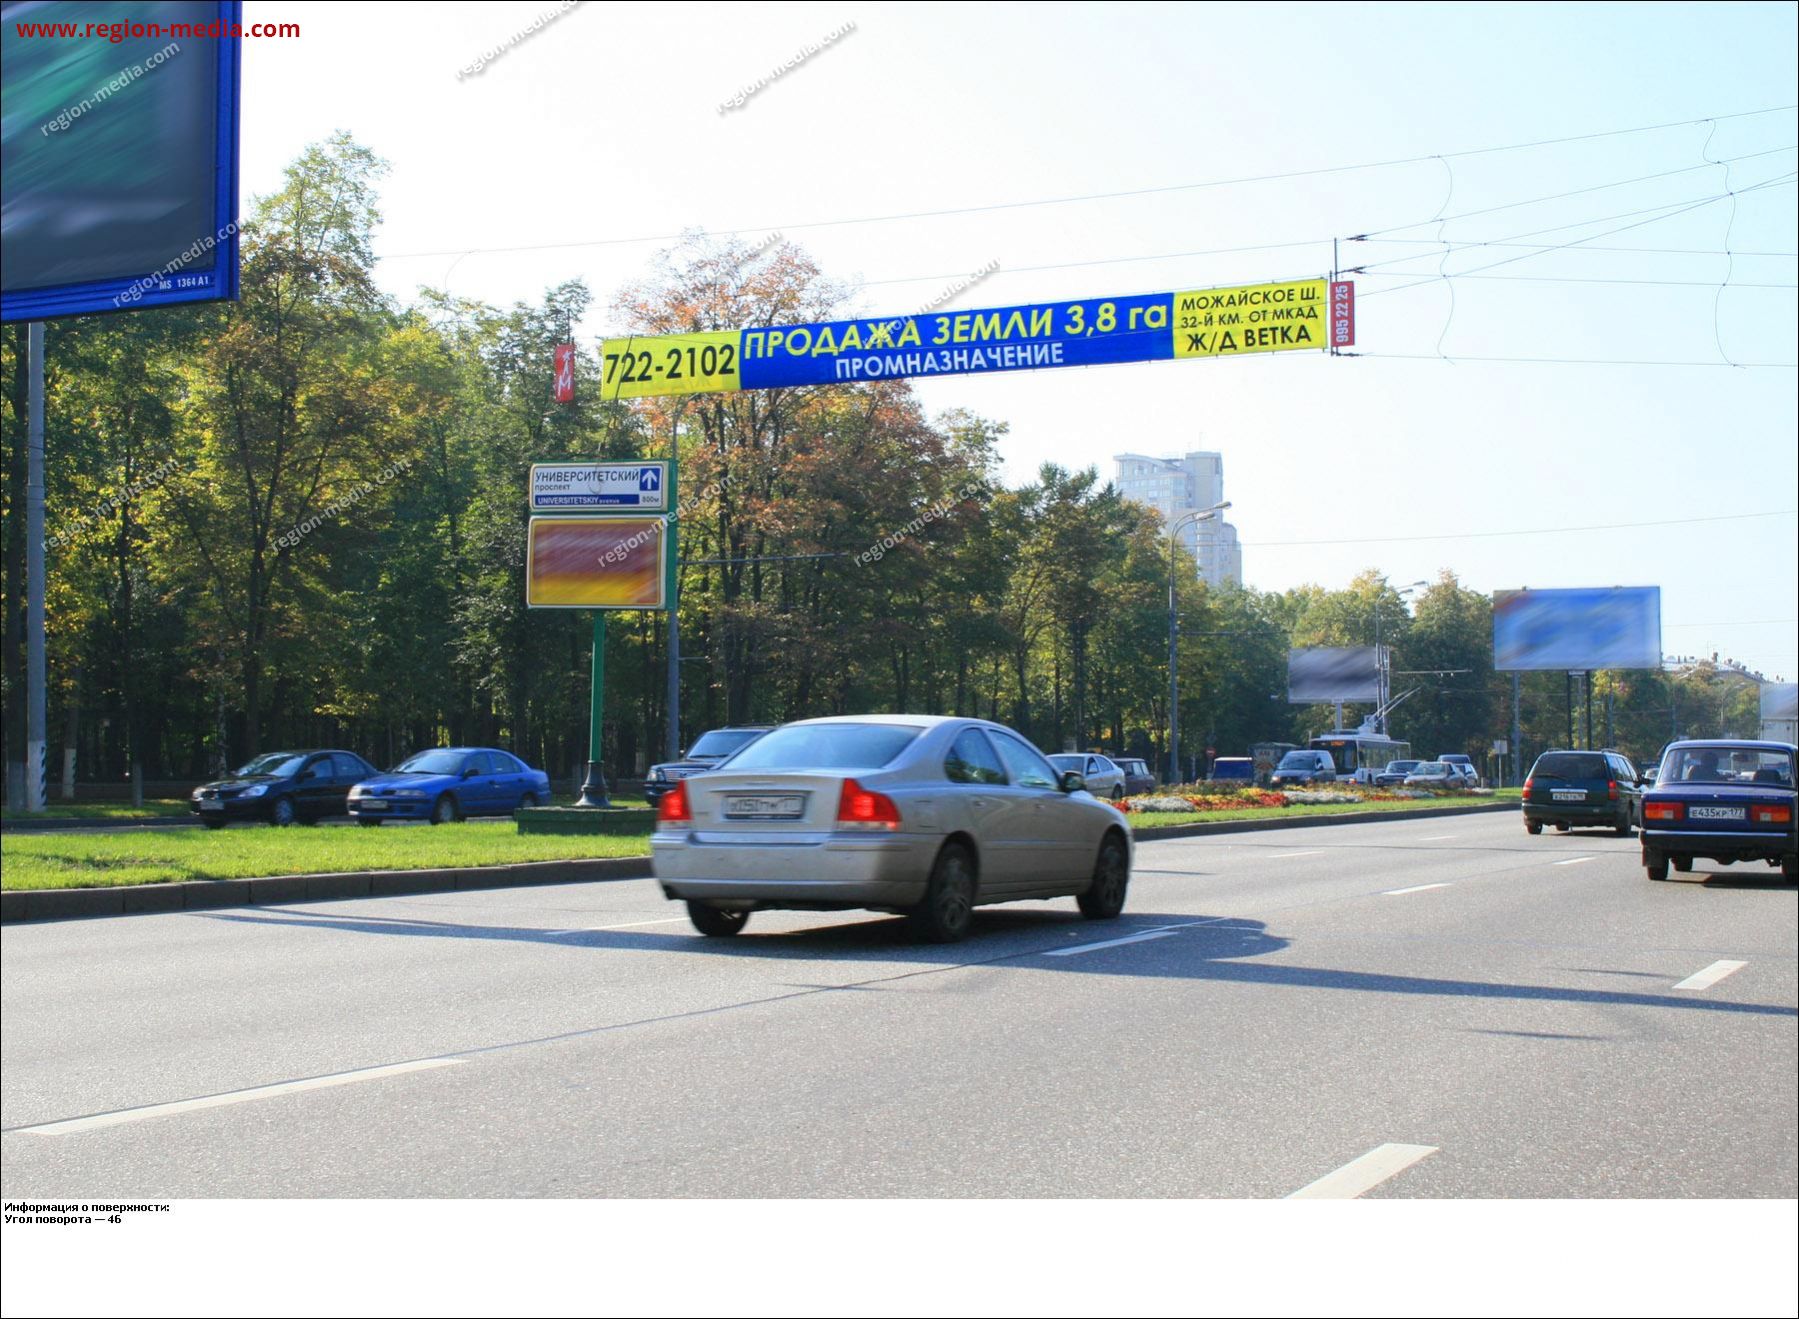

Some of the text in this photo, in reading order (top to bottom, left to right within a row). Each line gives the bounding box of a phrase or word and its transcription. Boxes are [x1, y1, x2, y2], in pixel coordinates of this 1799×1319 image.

[177, 278, 196, 287] 1364
[198, 276, 209, 285] A1
[1181, 287, 1321, 311] МОЖАЙСКОЕ Ш.
[1181, 305, 1318, 329] 32-Й КМ. ОТ МКАД
[1335, 285, 1349, 343] 995 22 25
[744, 302, 1167, 359] ПРОДАЖА ЗЕМЛИ 3,8 га
[1186, 325, 1312, 353] Ж/Д ВЕТКА
[605, 344, 736, 385] 722-2102
[835, 343, 1064, 379] ПРОМНАЗНАЧЕНИЕ
[535, 469, 640, 482] УНИВЕРСИТЕТСКИЙ
[537, 496, 599, 505] UNIVERSITETSKIY
